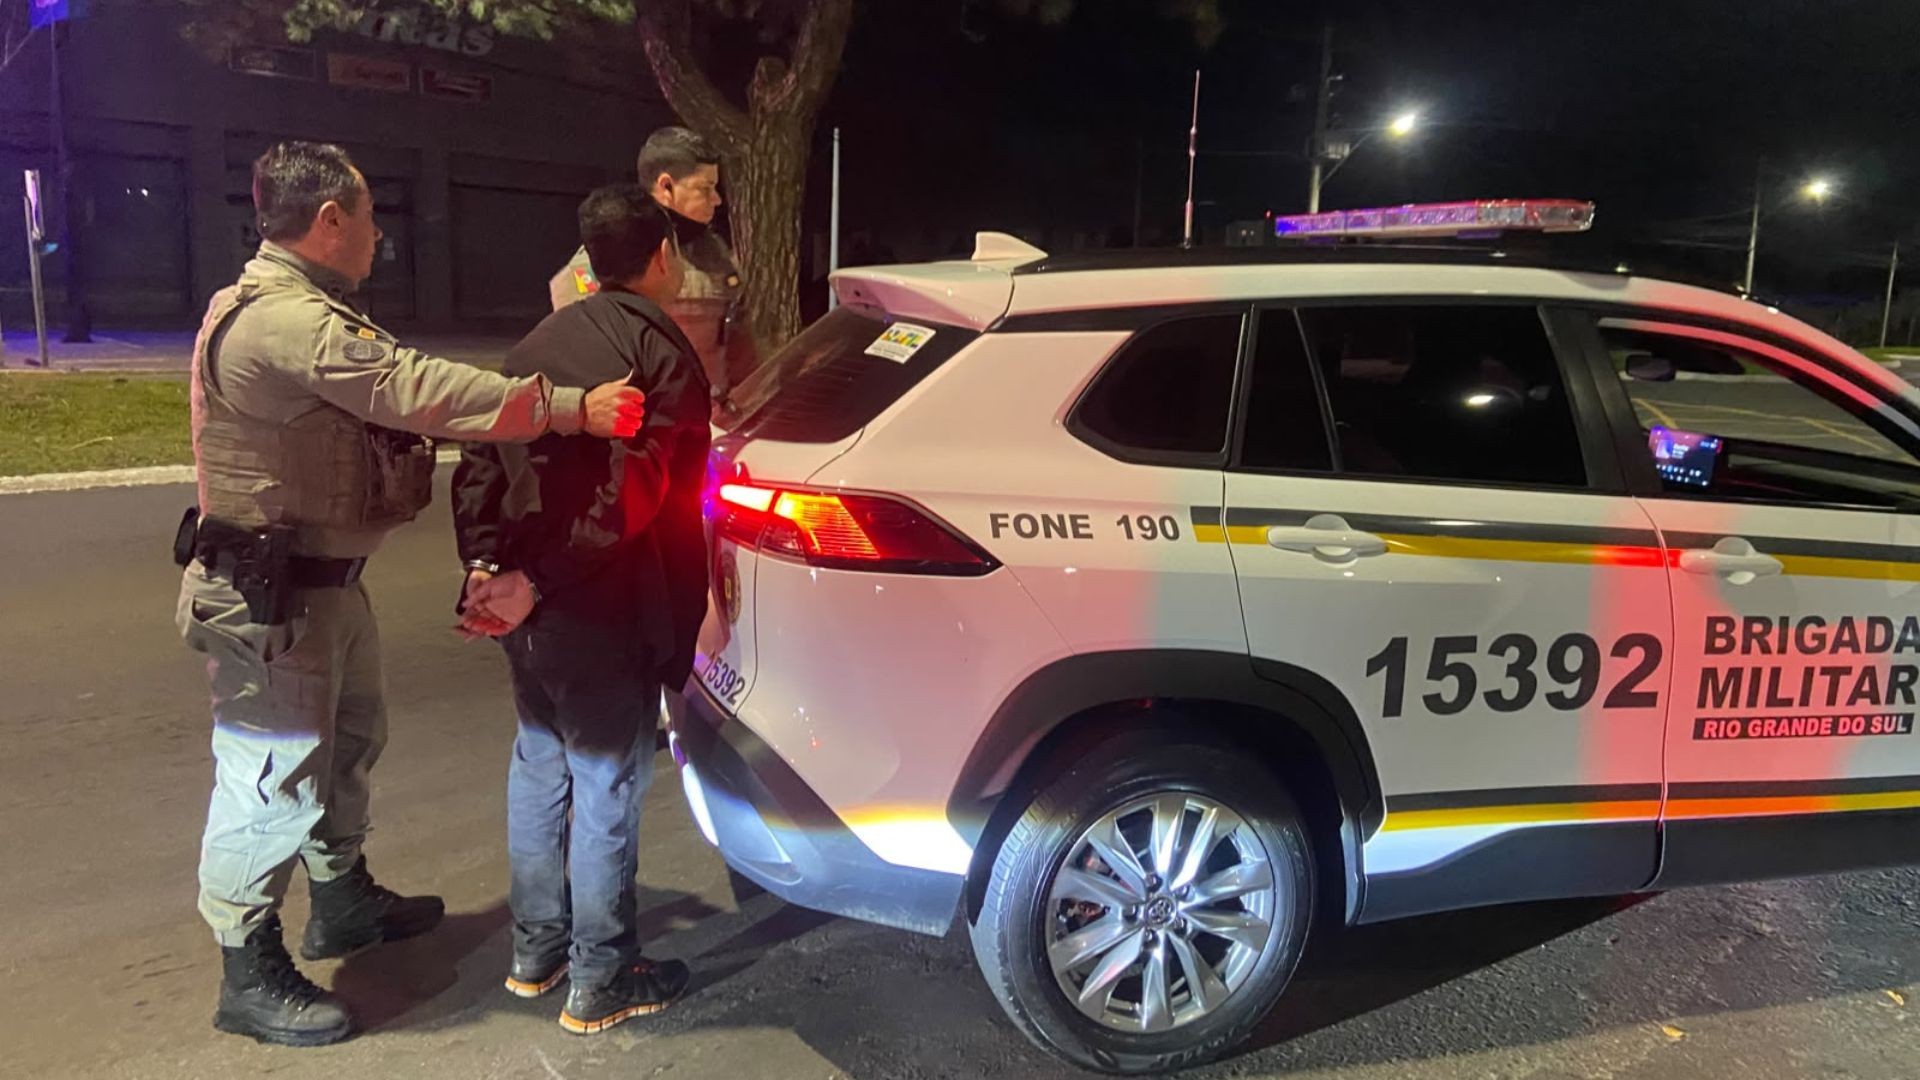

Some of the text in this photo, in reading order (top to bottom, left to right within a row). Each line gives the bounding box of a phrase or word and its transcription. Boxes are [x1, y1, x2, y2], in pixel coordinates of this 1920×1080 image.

[989, 513, 1180, 541] FONE 190
[1704, 615, 1920, 655] BRIGADA
[703, 656, 746, 706] 15392
[1366, 632, 1663, 718] 15392
[1697, 664, 1919, 709] MILITAR
[1703, 715, 1908, 738] RIO GRANDE DO SUL
